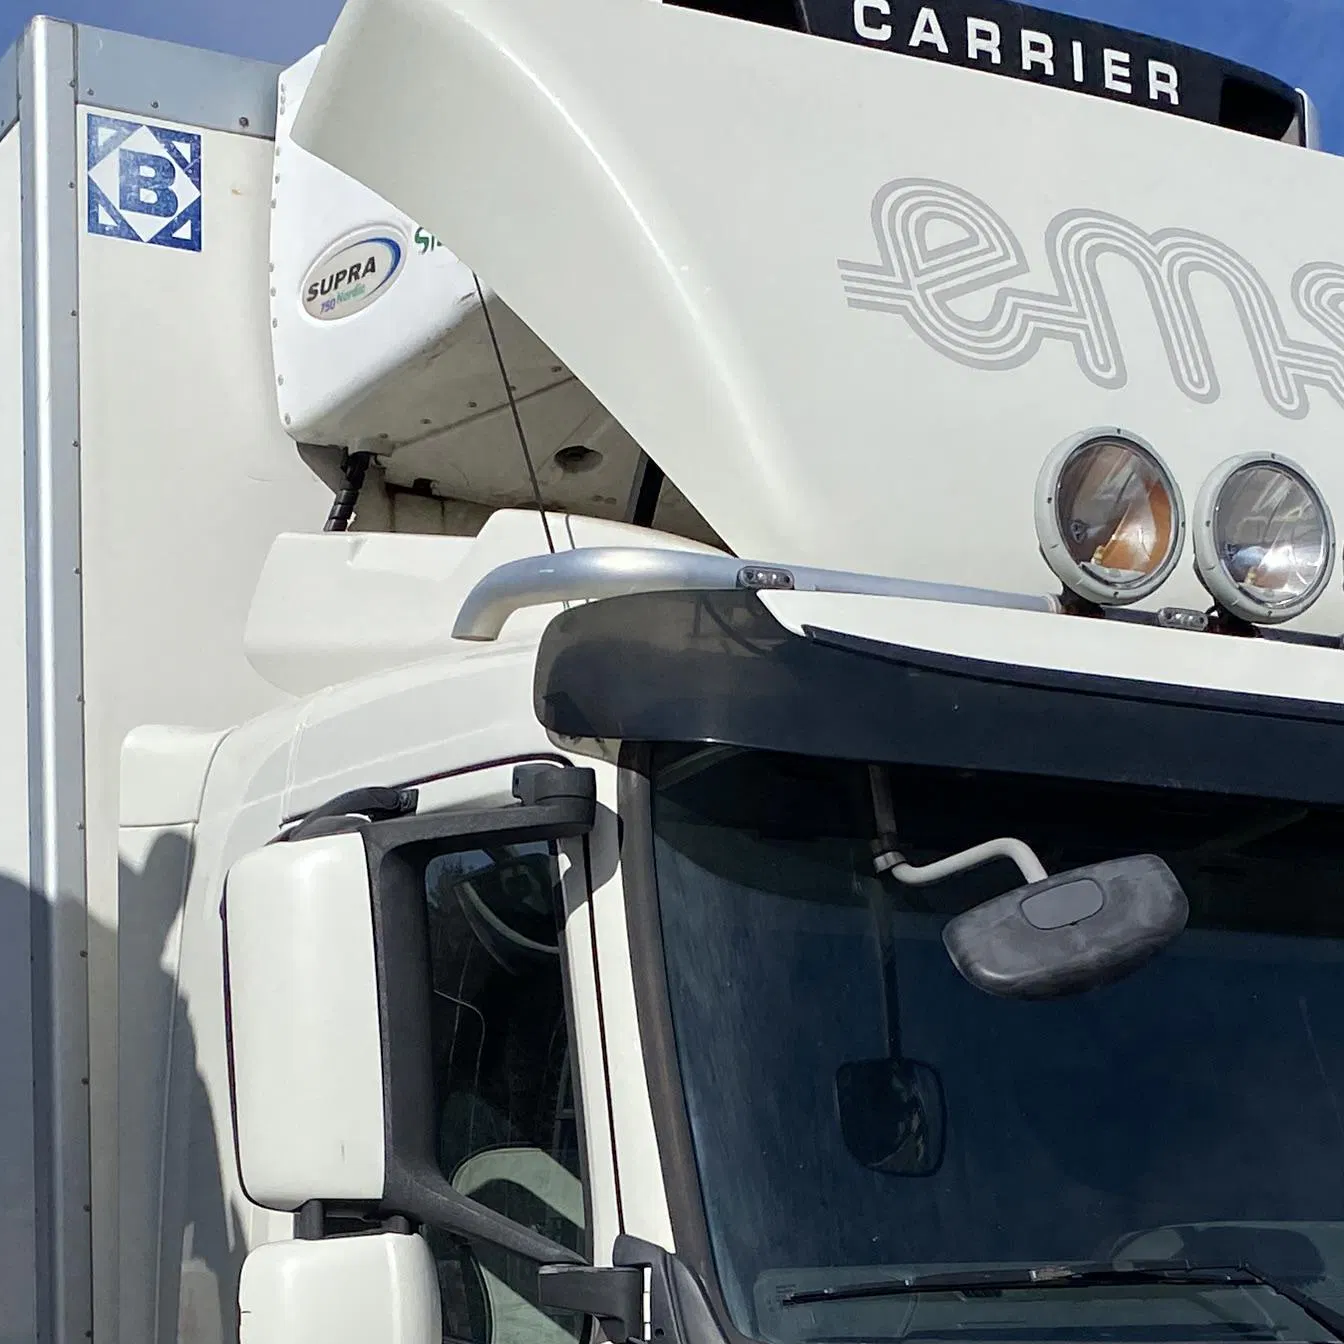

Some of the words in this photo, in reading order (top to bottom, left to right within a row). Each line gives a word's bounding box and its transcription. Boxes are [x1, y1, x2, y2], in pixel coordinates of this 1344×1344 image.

[853, 0, 1180, 106] CARRIER
[118, 153, 179, 219] B
[307, 256, 376, 302] SUPRA
